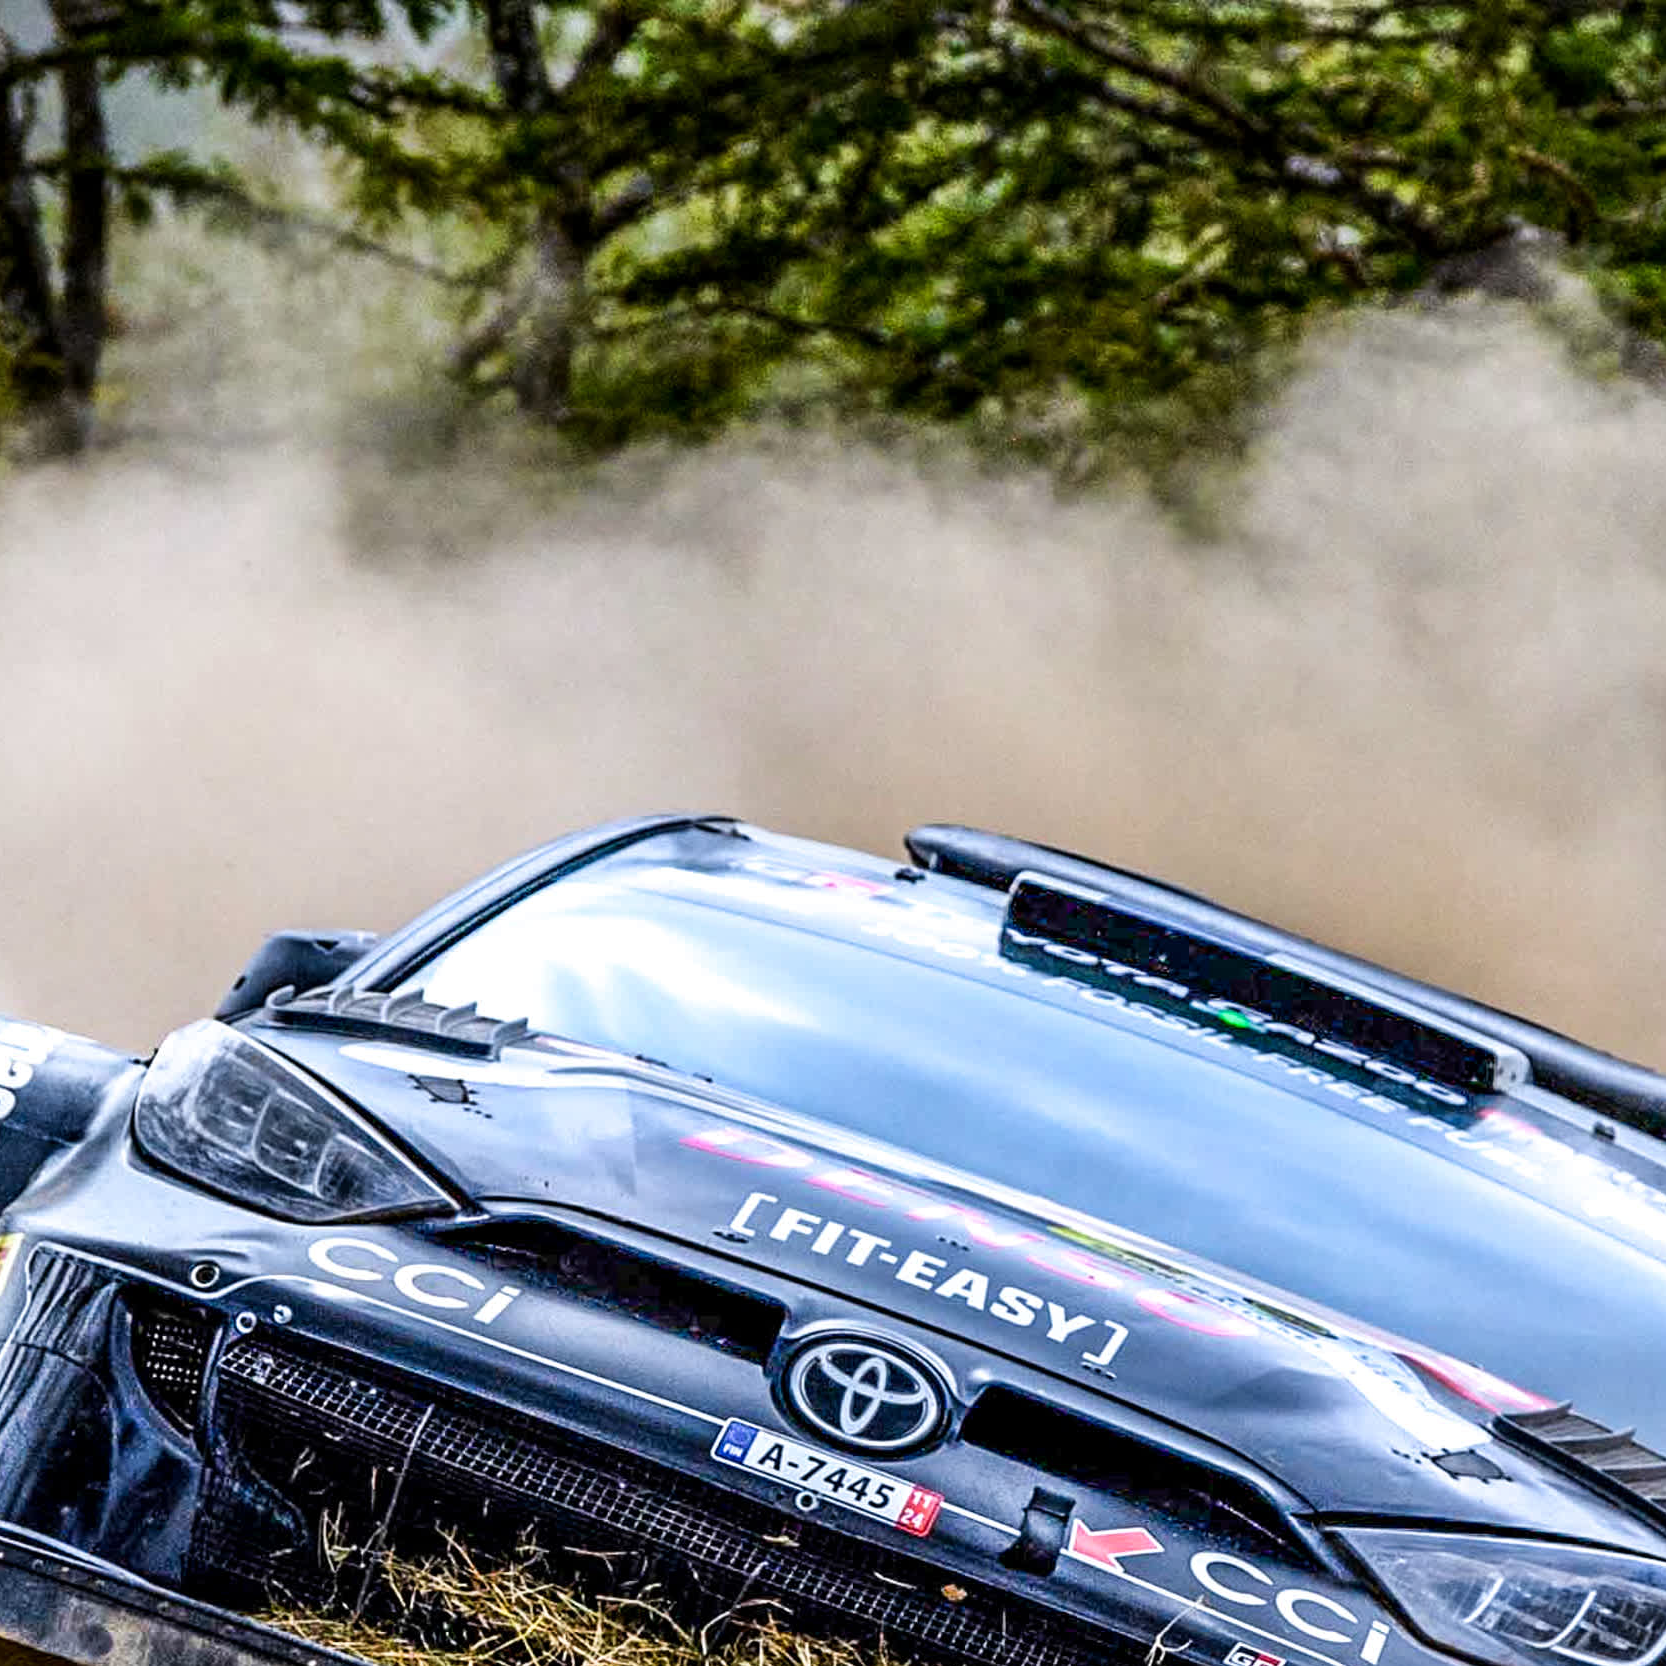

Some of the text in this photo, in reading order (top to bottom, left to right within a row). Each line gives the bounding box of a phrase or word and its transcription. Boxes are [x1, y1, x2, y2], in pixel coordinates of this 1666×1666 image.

[678, 1128, 1260, 1338] DENSO
[758, 1443, 895, 1509] A-7445
[900, 1509, 925, 1528] 24
